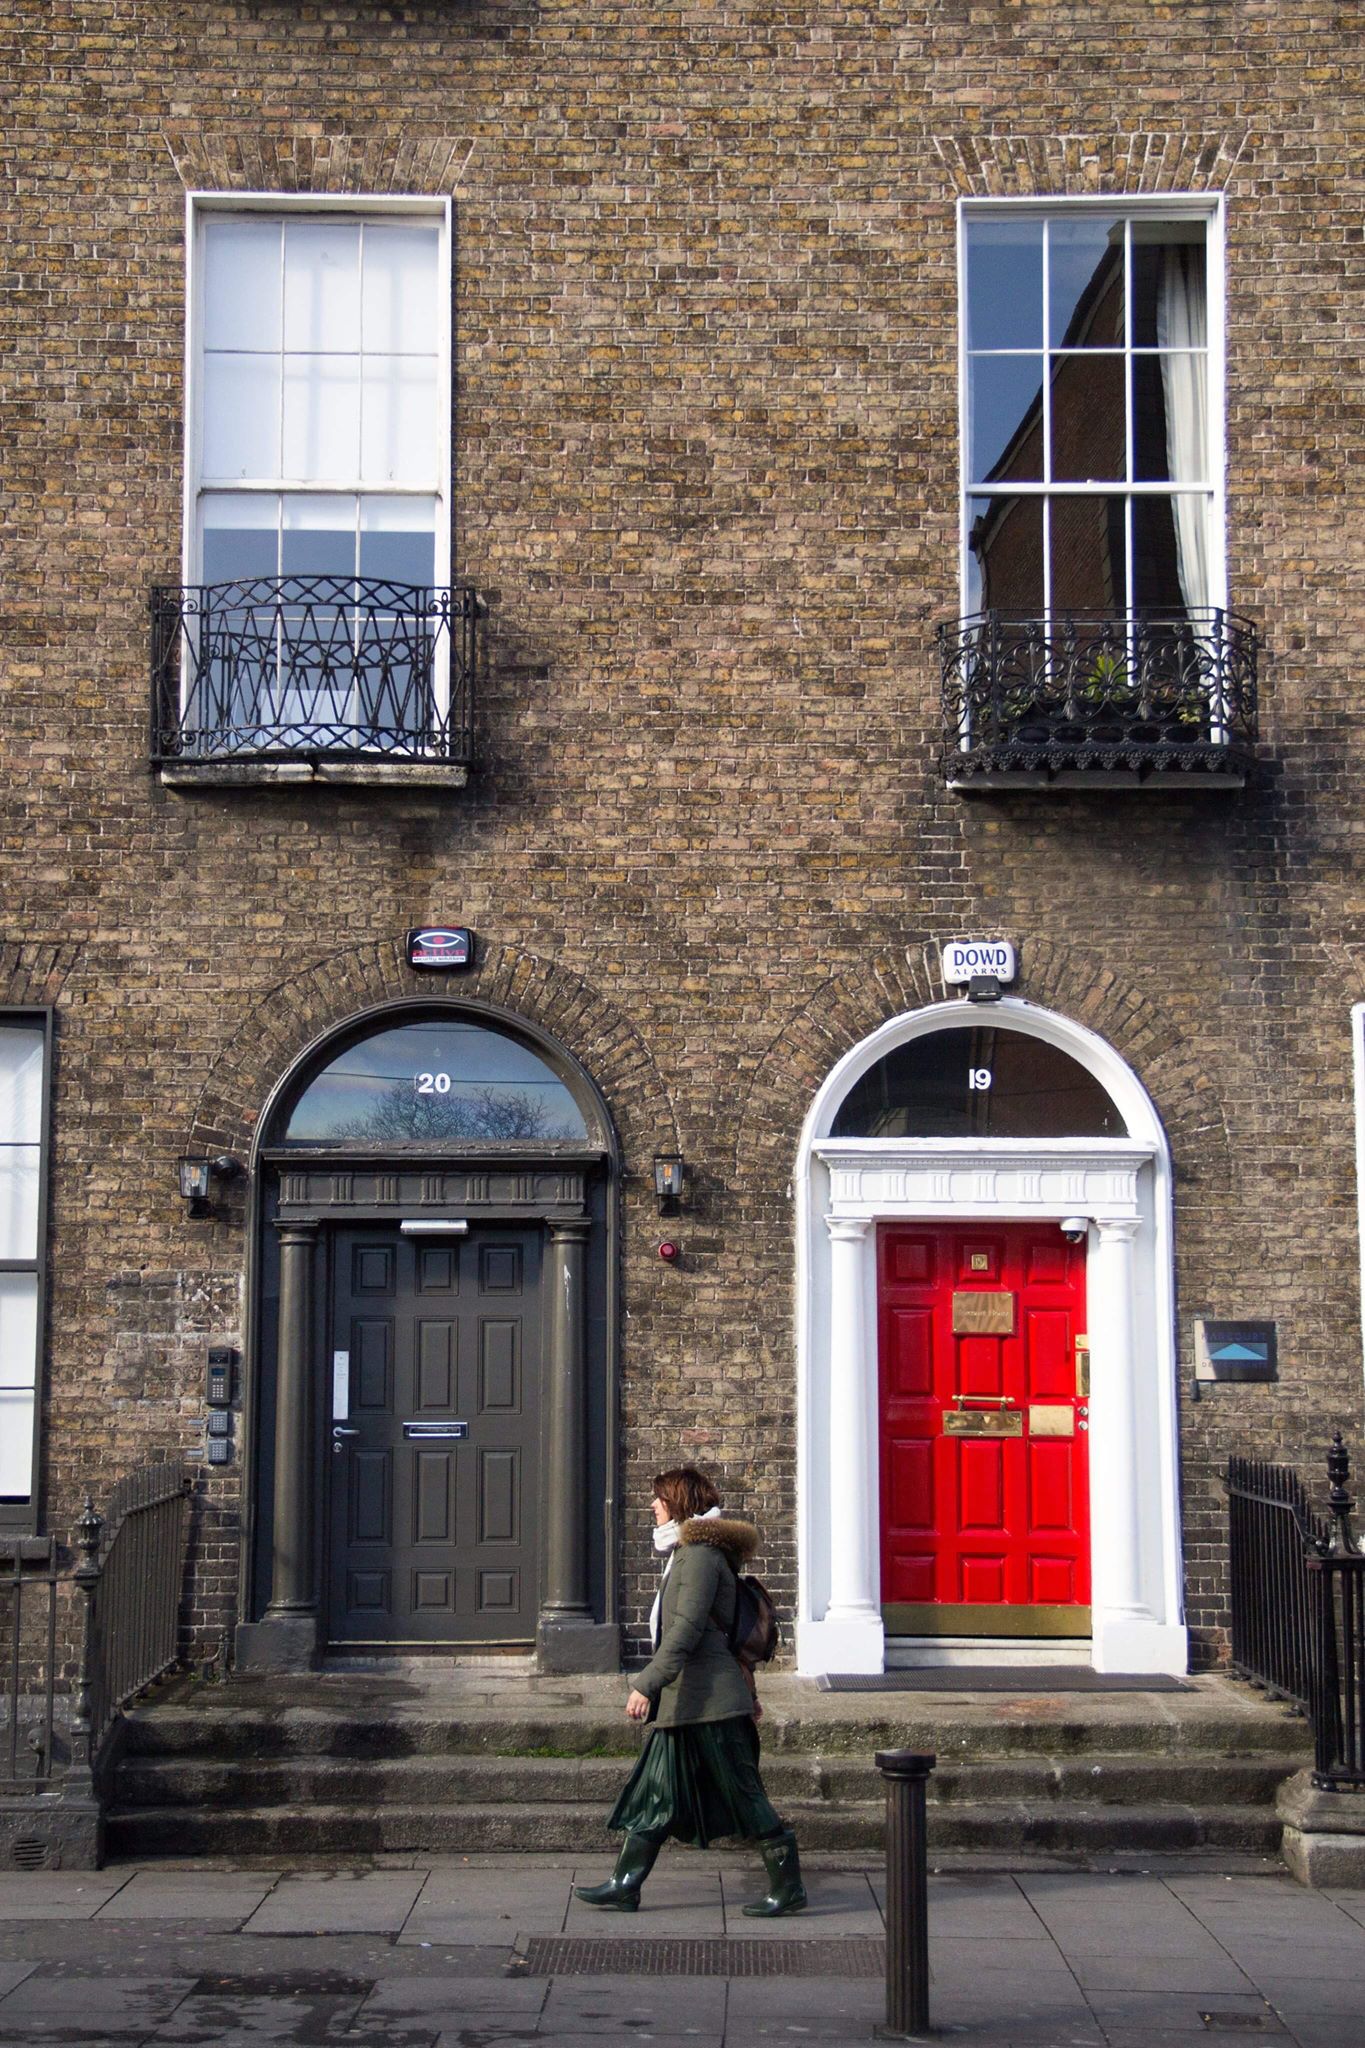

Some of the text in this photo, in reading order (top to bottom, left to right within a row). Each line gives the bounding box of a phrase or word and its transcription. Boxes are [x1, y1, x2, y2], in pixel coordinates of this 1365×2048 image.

[412, 947, 465, 956] active
[954, 949, 1007, 966] DOWD
[418, 1073, 451, 1094] 20
[968, 1068, 992, 1090] 19
